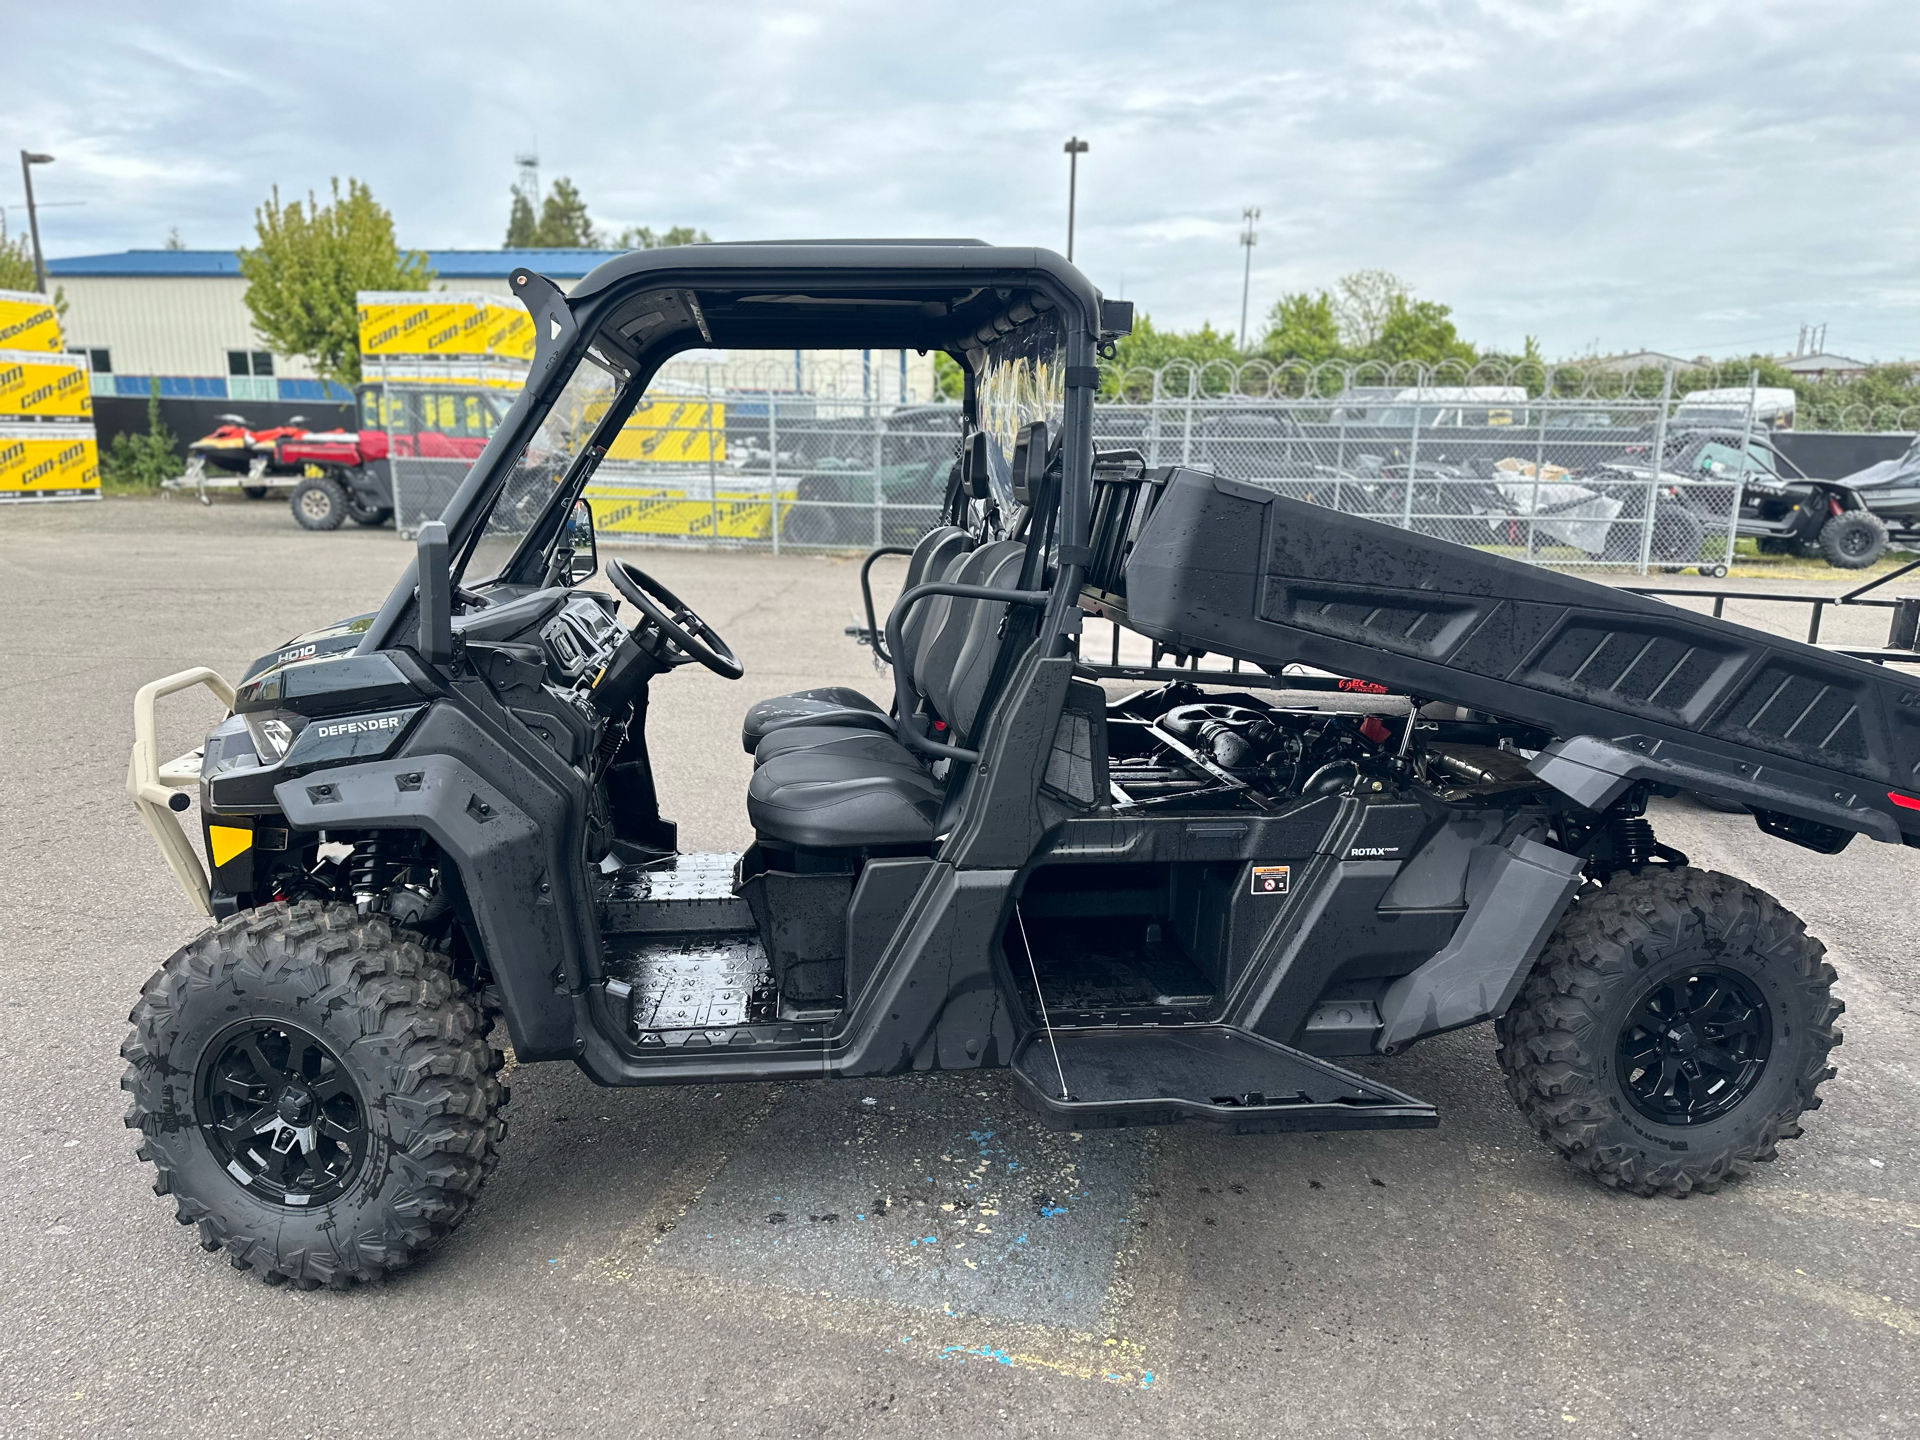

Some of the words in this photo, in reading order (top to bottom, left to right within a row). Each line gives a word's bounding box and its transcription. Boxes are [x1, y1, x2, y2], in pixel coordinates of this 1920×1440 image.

[368, 309, 429, 349] can-am
[21, 370, 83, 409] can-am
[22, 442, 84, 485] can-am
[278, 645, 316, 664] HD10
[318, 717, 399, 738] DEFENDER
[1351, 848, 1385, 856] ROTAX
